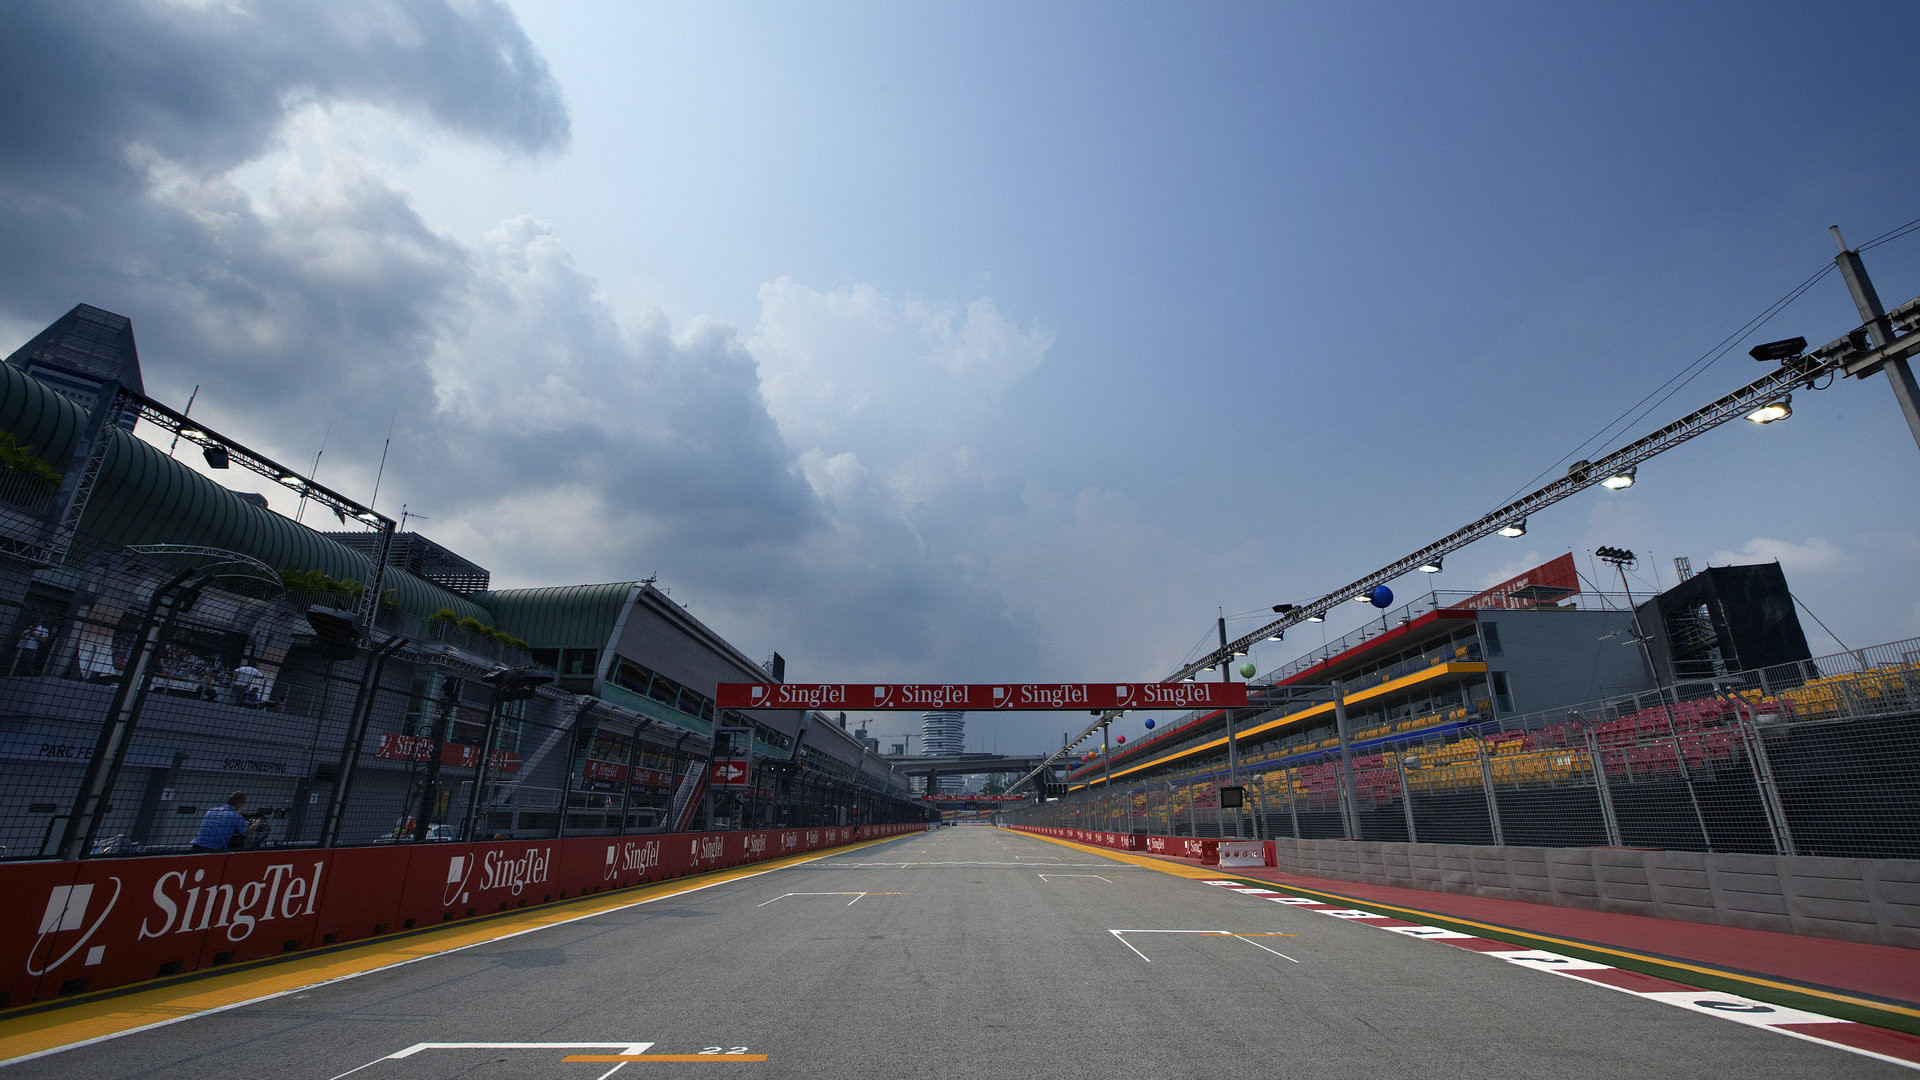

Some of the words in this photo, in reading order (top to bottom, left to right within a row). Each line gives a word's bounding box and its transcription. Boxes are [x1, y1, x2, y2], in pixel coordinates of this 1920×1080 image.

[779, 684, 846, 707] SingTel
[902, 684, 970, 707] SingTel
[1021, 684, 1088, 707] SingTel
[1144, 684, 1211, 707] SingTel
[39, 743, 75, 759] PARC
[223, 757, 288, 774] SCRUTINEERING
[701, 836, 724, 864] SingTel
[750, 834, 767, 856] SingTel
[1151, 838, 1165, 852] SingTel
[622, 841, 660, 876] SingTel
[479, 847, 550, 896] SingTel
[137, 861, 325, 942] SingTel
[698, 1046, 748, 1054] 22
